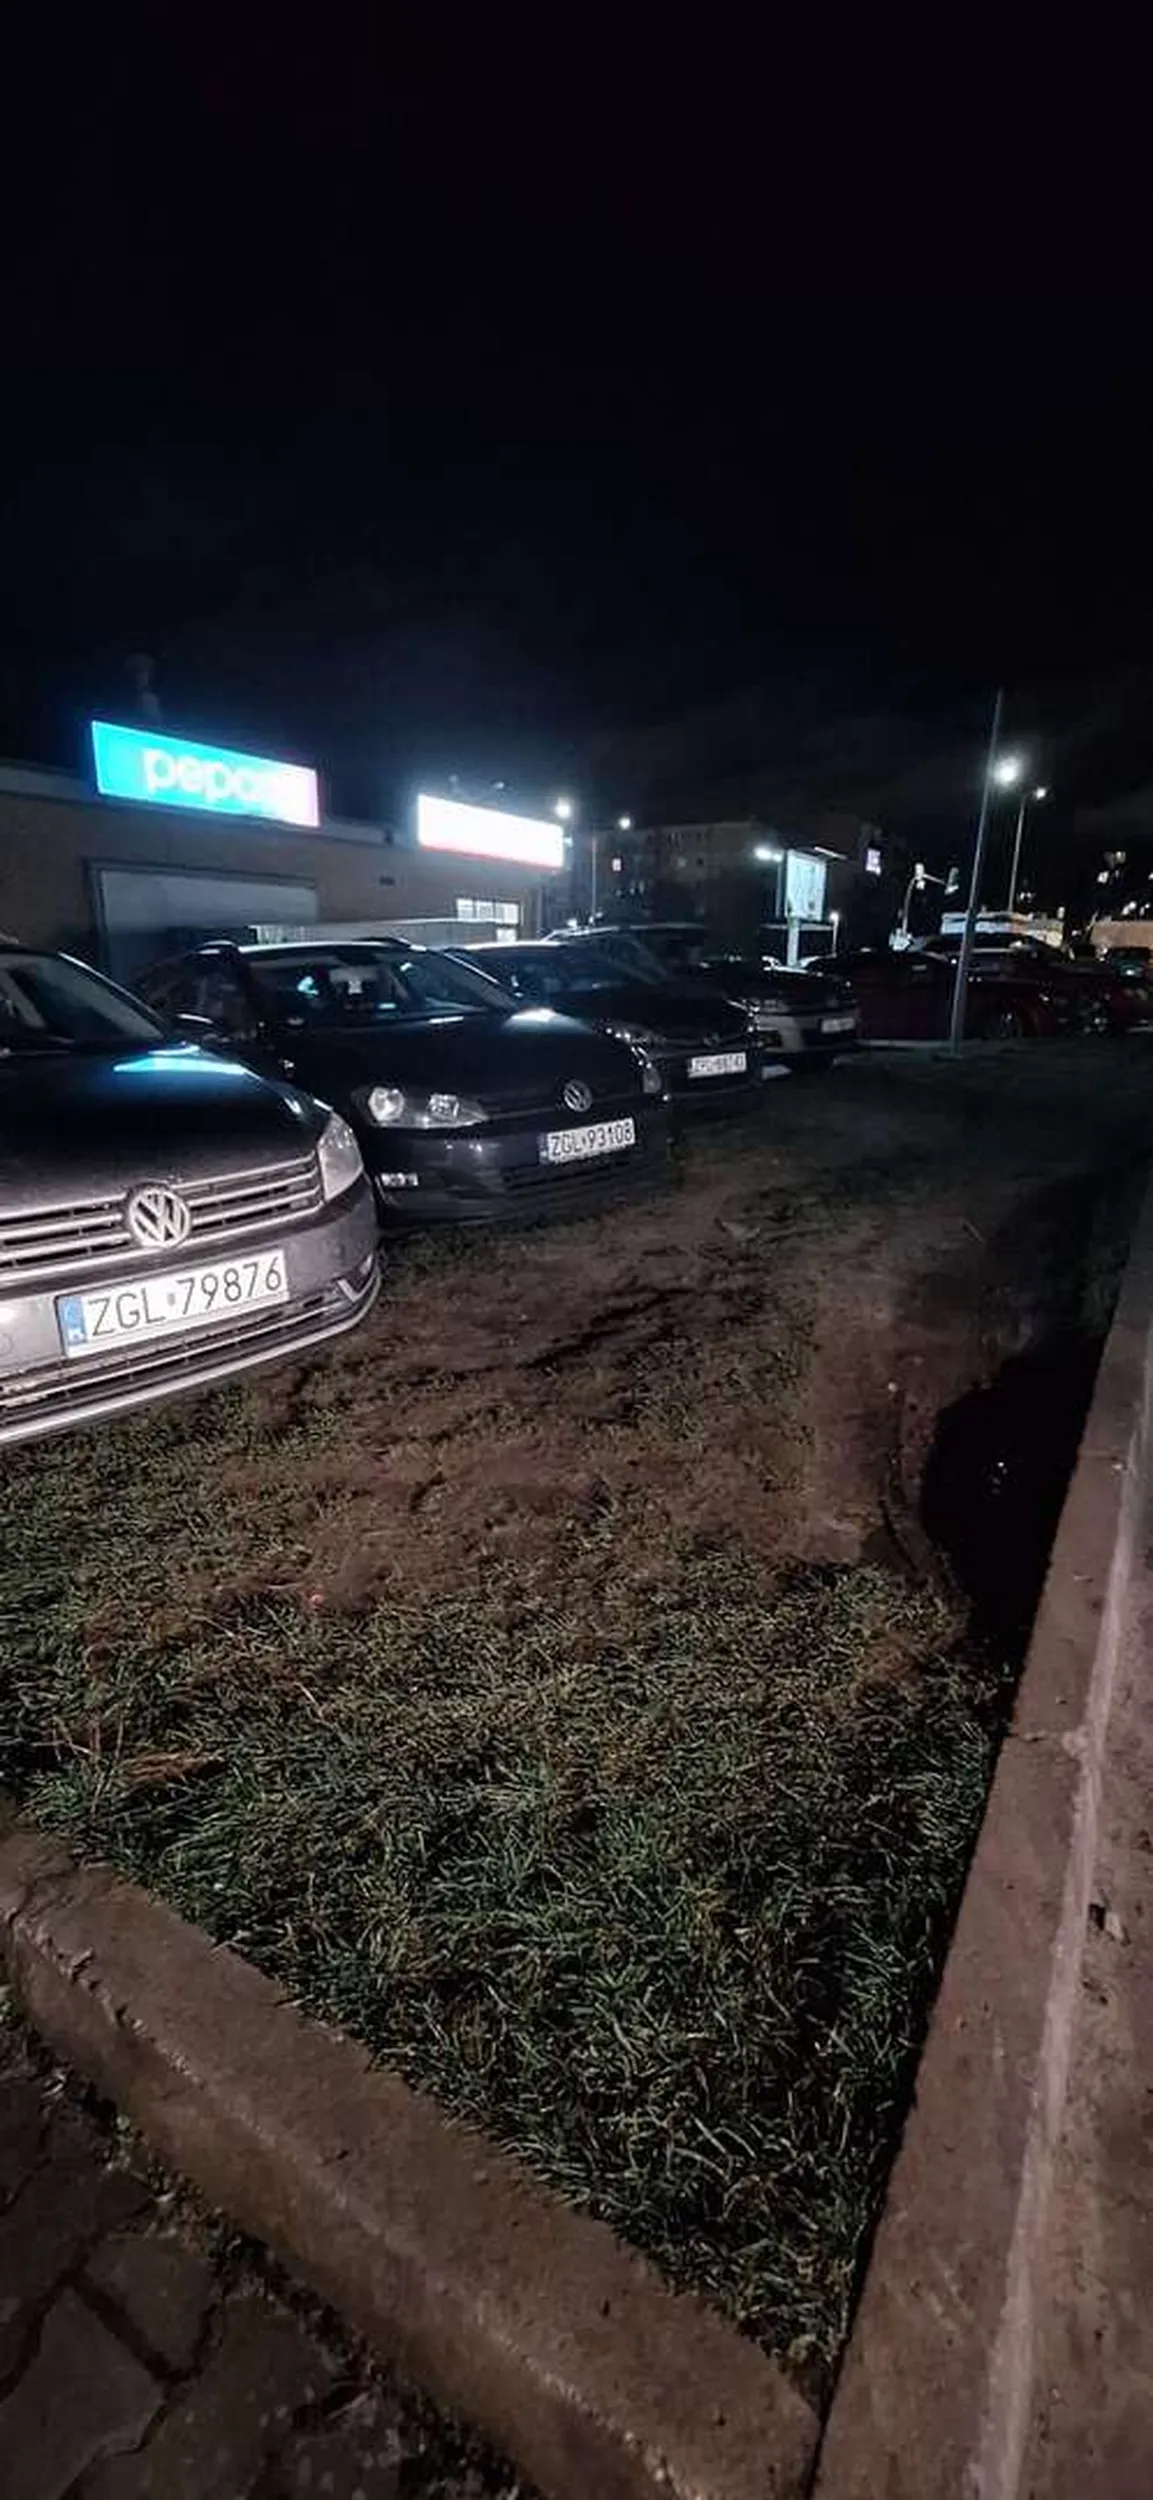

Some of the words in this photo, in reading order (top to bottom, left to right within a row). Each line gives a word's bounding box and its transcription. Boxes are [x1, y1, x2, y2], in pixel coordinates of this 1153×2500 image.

[143, 749, 285, 804] pepc
[551, 1132, 582, 1156] ZGL
[587, 1121, 633, 1149] 93108
[88, 1287, 167, 1336] ZGL
[176, 1256, 282, 1315] 79876
